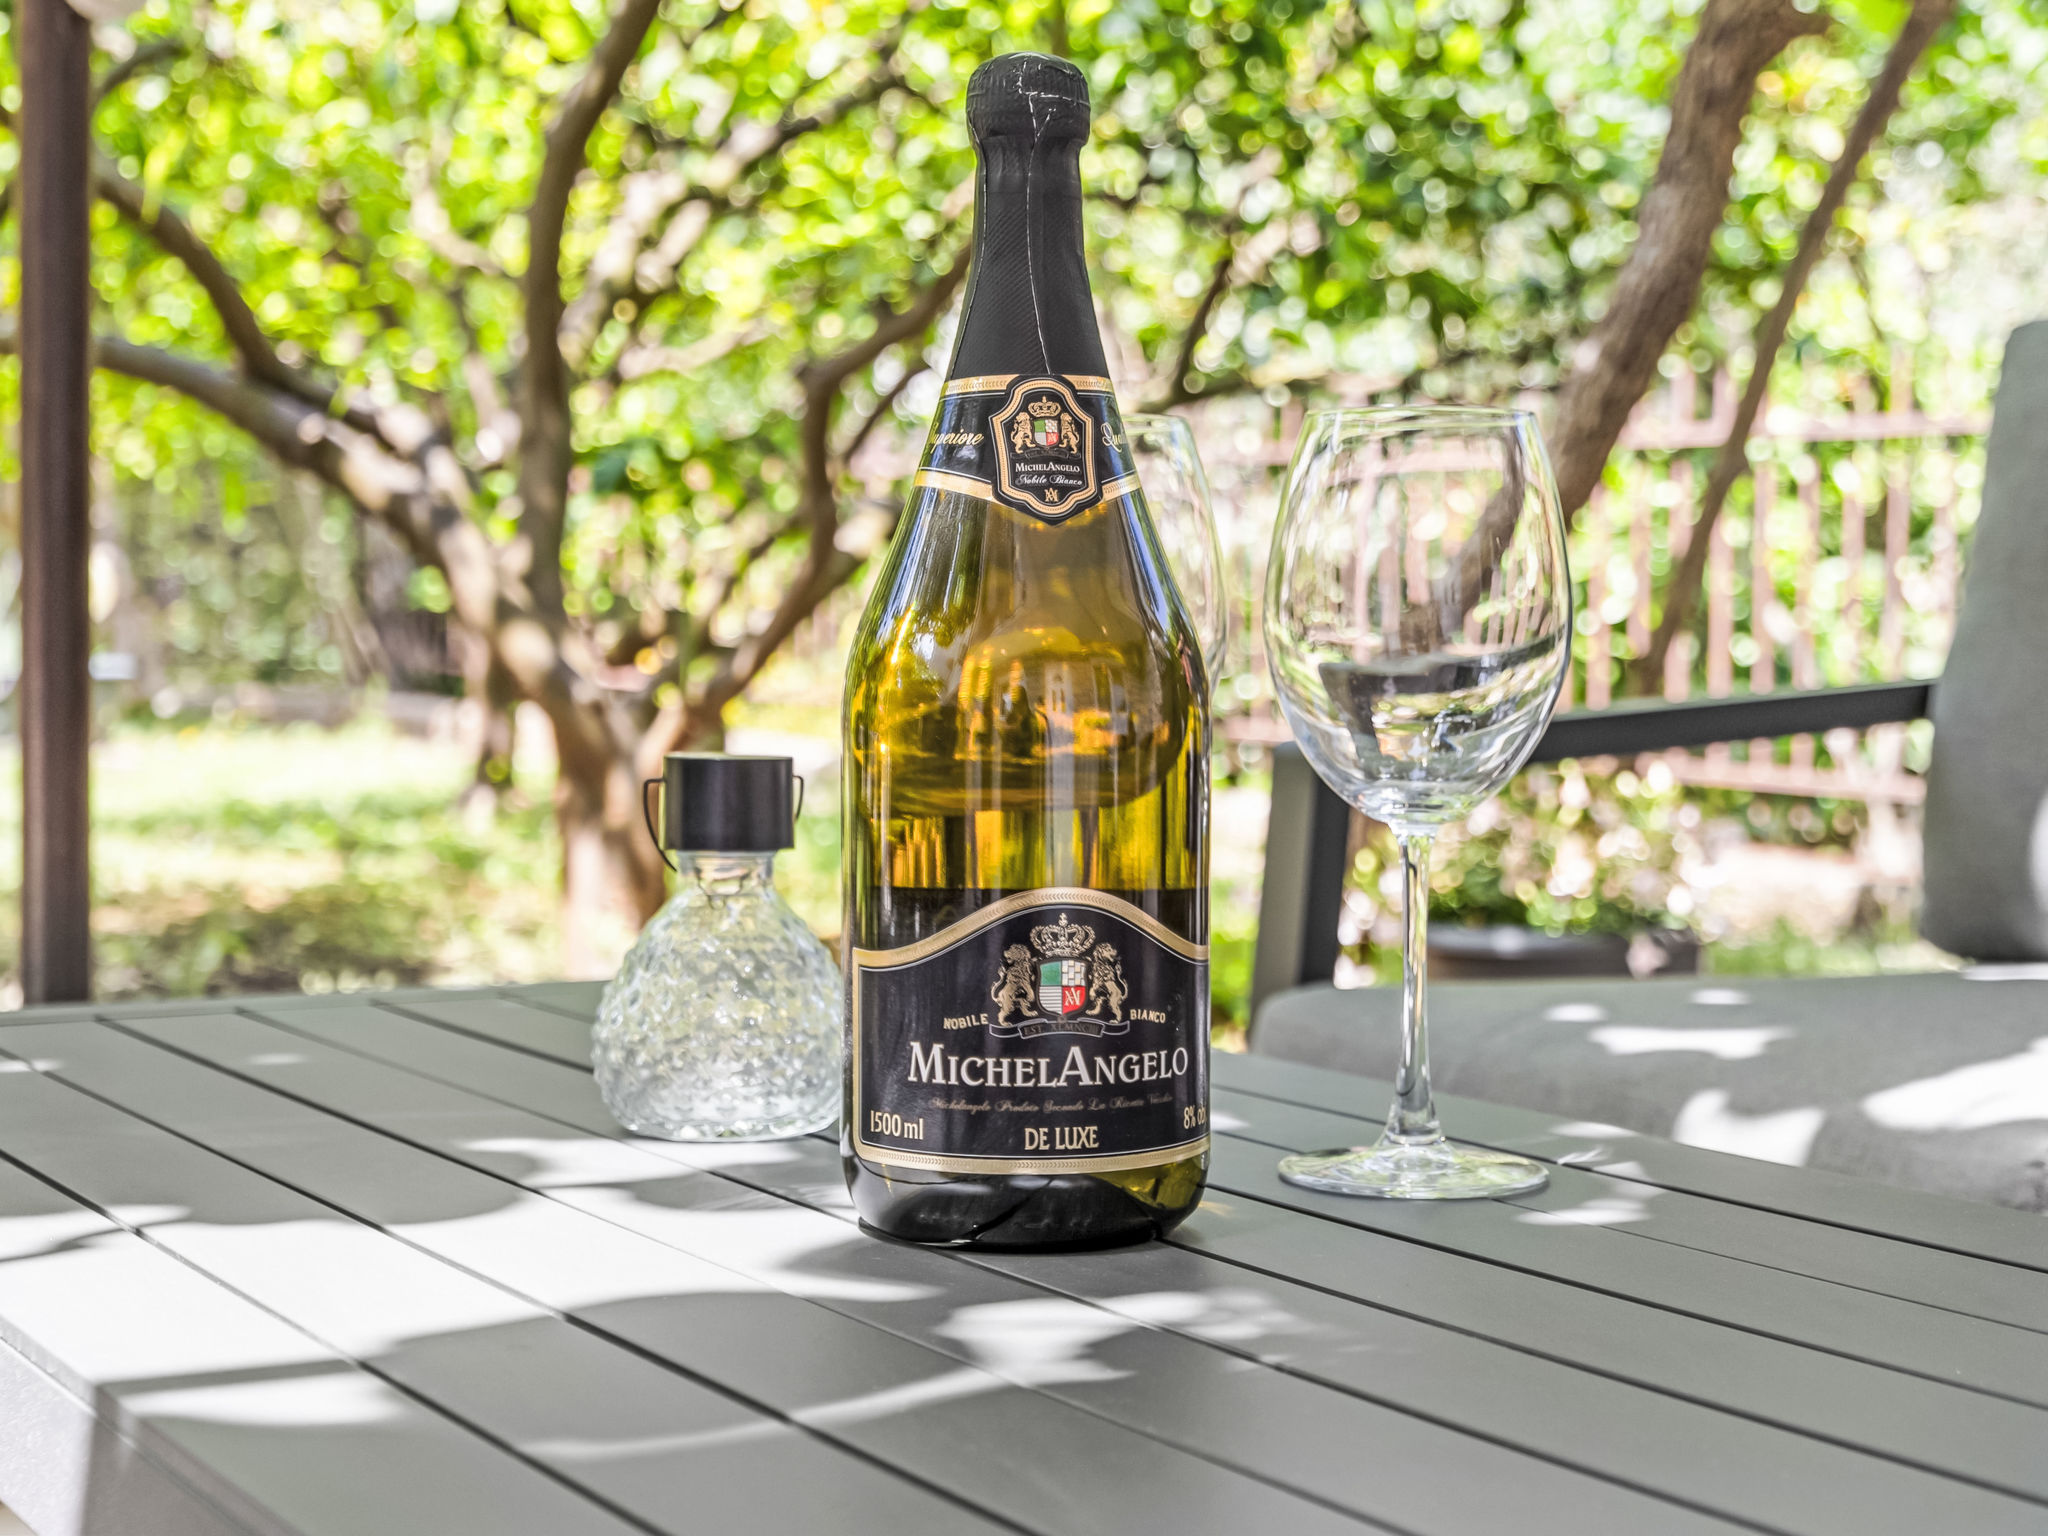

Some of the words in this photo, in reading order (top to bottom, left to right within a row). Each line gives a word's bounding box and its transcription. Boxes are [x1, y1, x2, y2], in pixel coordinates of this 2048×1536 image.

[1015, 474, 1047, 486] Nobile
[1049, 474, 1083, 486] Bianco
[943, 1013, 989, 1031] NOBILE
[1129, 1008, 1167, 1024] BIANCO
[870, 1109, 901, 1138] 1500
[904, 1117, 924, 1141] ml
[1183, 1104, 1197, 1130] 8%
[1023, 1128, 1050, 1151] DE
[1054, 1126, 1100, 1151] LUXE
